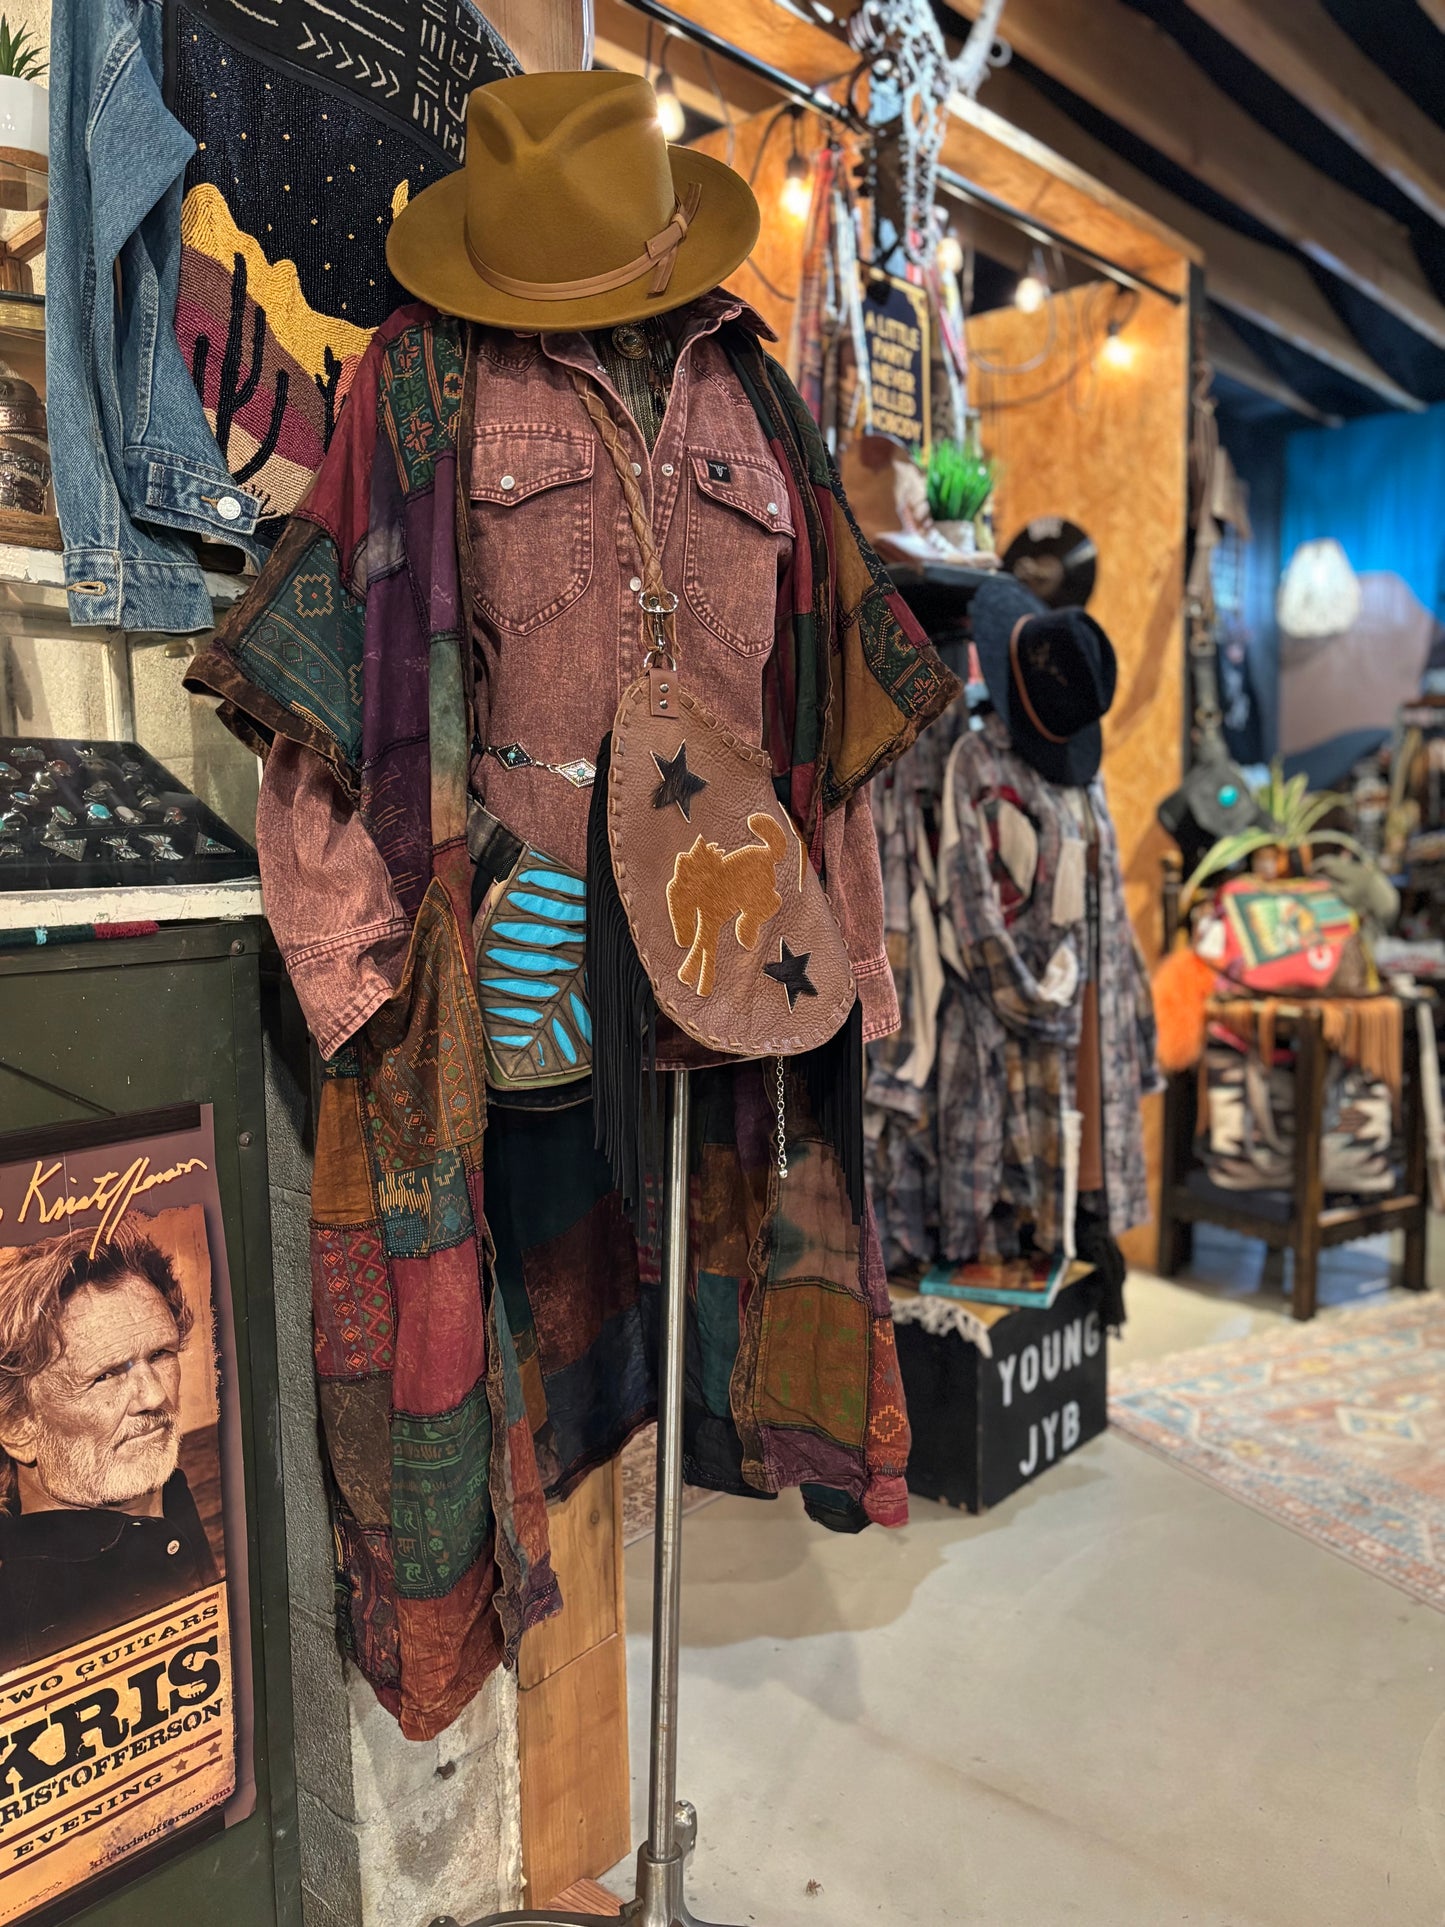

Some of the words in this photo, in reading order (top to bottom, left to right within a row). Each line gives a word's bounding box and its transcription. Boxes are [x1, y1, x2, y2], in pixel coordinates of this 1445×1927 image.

[865, 310, 876, 333] A
[877, 314, 920, 352] LITTLE
[871, 336, 914, 370] PARTY
[871, 360, 916, 395] NEVER
[872, 385, 917, 417] KILLED
[998, 1310, 1099, 1407] YOUNG
[1019, 1400, 1080, 1476] JYB
[0, 1674, 63, 1712] WO
[76, 1605, 219, 1677] GUITARS
[0, 1699, 223, 1834] RISTOFFERSON
[13, 1772, 164, 1860] EVENING
[89, 1786, 232, 1870] kriskristofferson.com
